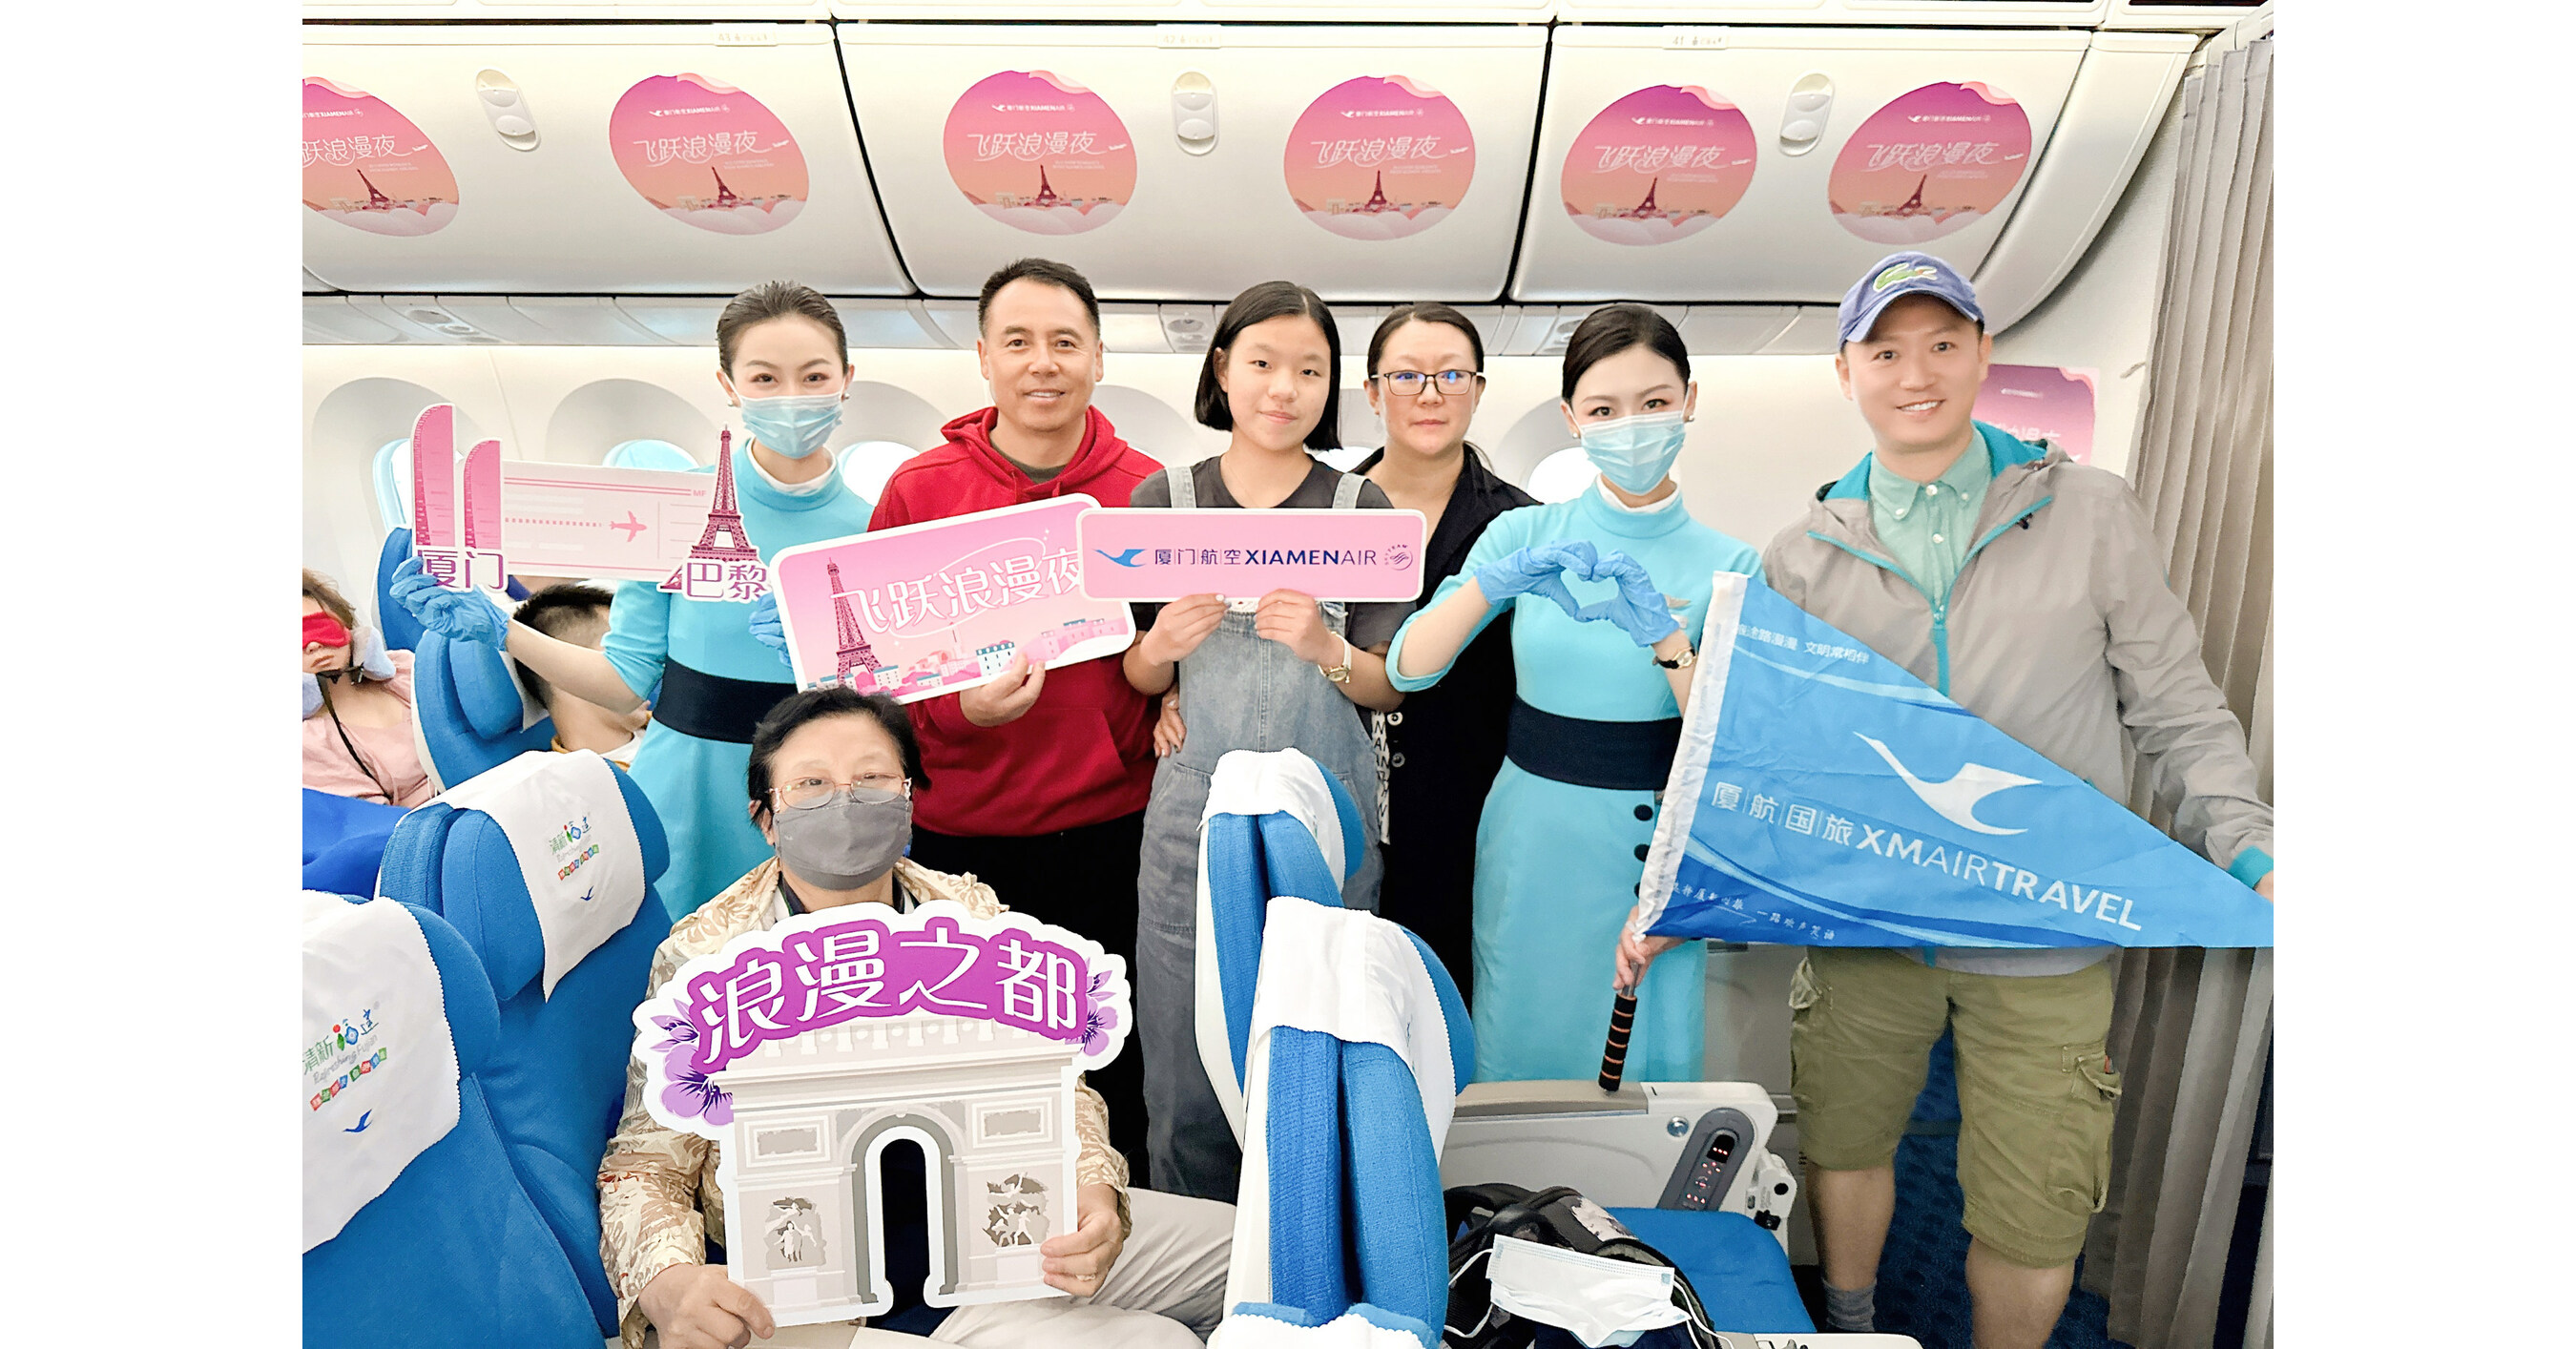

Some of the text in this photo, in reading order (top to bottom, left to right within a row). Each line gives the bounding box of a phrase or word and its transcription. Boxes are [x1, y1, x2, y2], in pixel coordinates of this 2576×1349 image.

[634, 130, 763, 167] 飞跃浪漫夜
[967, 131, 1102, 161] 飞跃浪漫夜
[1311, 135, 1444, 169] 飞跃浪漫夜
[418, 550, 504, 590] 厦门
[1154, 549, 1377, 565] 厦门航空 XIAMENAIR
[687, 563, 768, 600] 巴黎
[830, 548, 1080, 633] 飞跃浪漫夜
[1712, 781, 2142, 931] 厦航国旅 XMAIRTRAVEL
[699, 926, 1078, 1065] 浪漫之都
